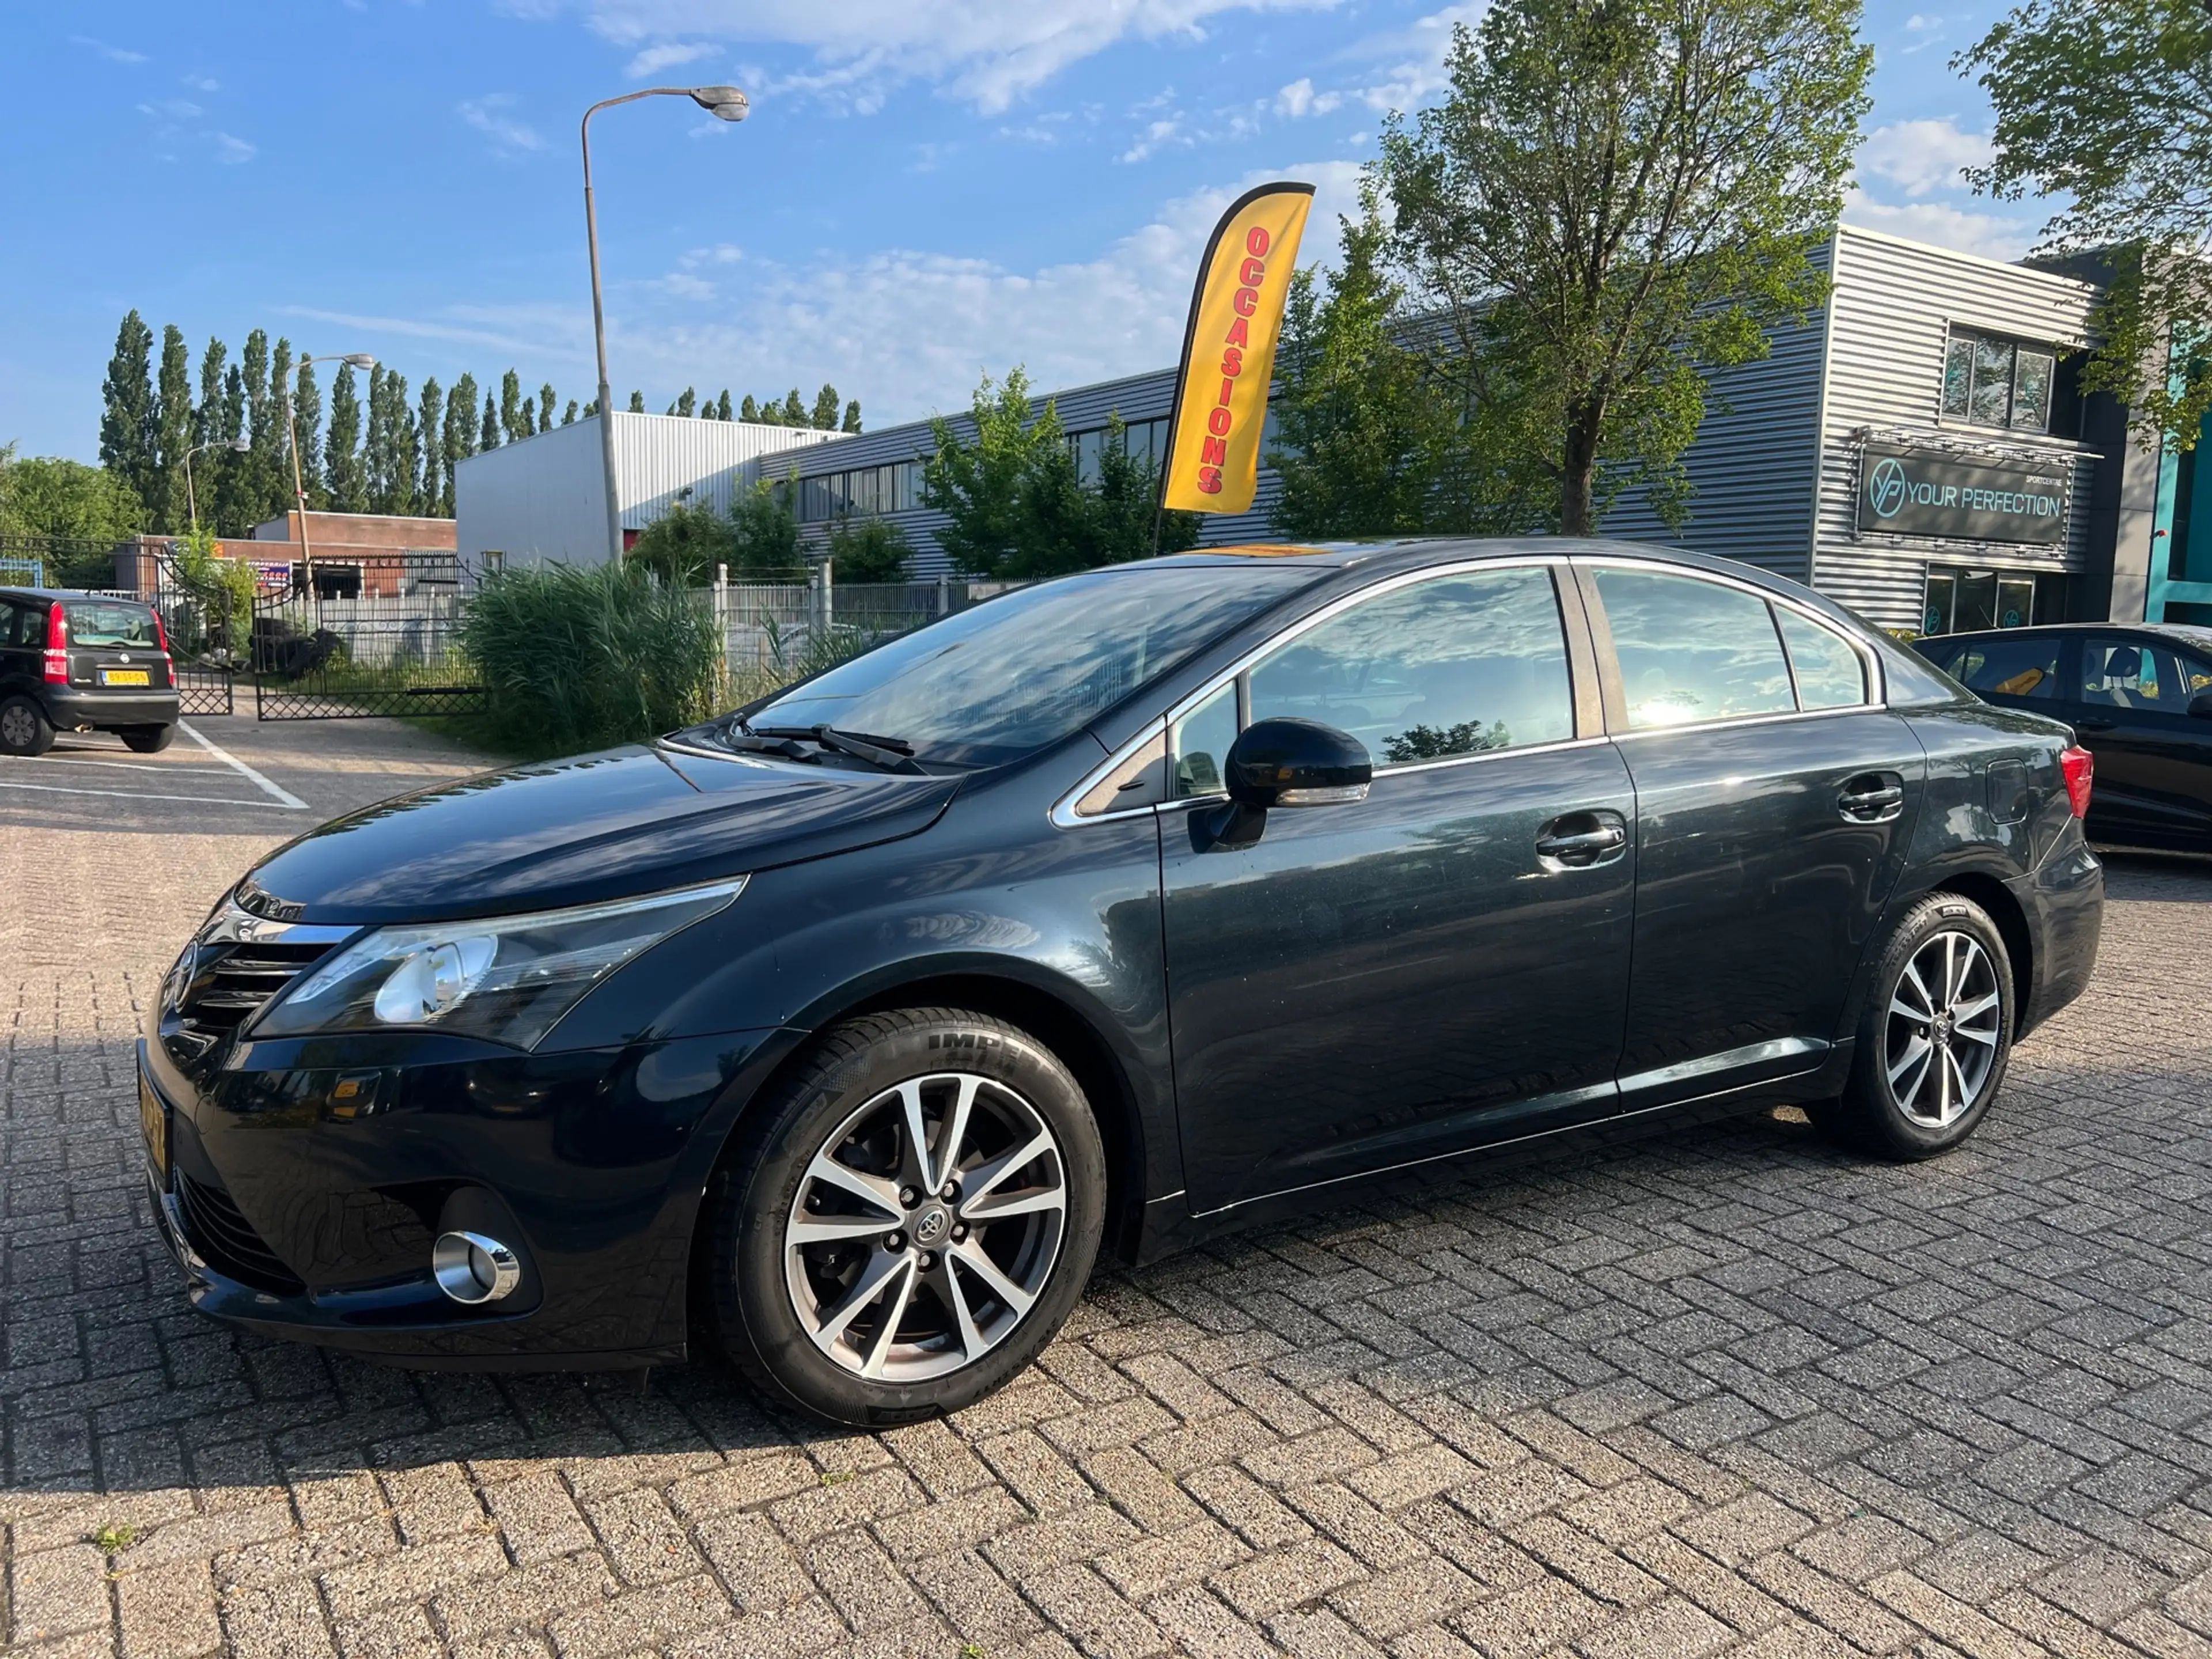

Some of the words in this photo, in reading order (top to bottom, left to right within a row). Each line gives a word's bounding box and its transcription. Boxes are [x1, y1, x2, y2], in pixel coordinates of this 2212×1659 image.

[1198, 226, 1270, 494] OCCASIONS
[1907, 481, 1957, 508] YOUR
[1961, 487, 2061, 517] PERFECTION
[2025, 475, 2062, 487] SPORTCENTRE
